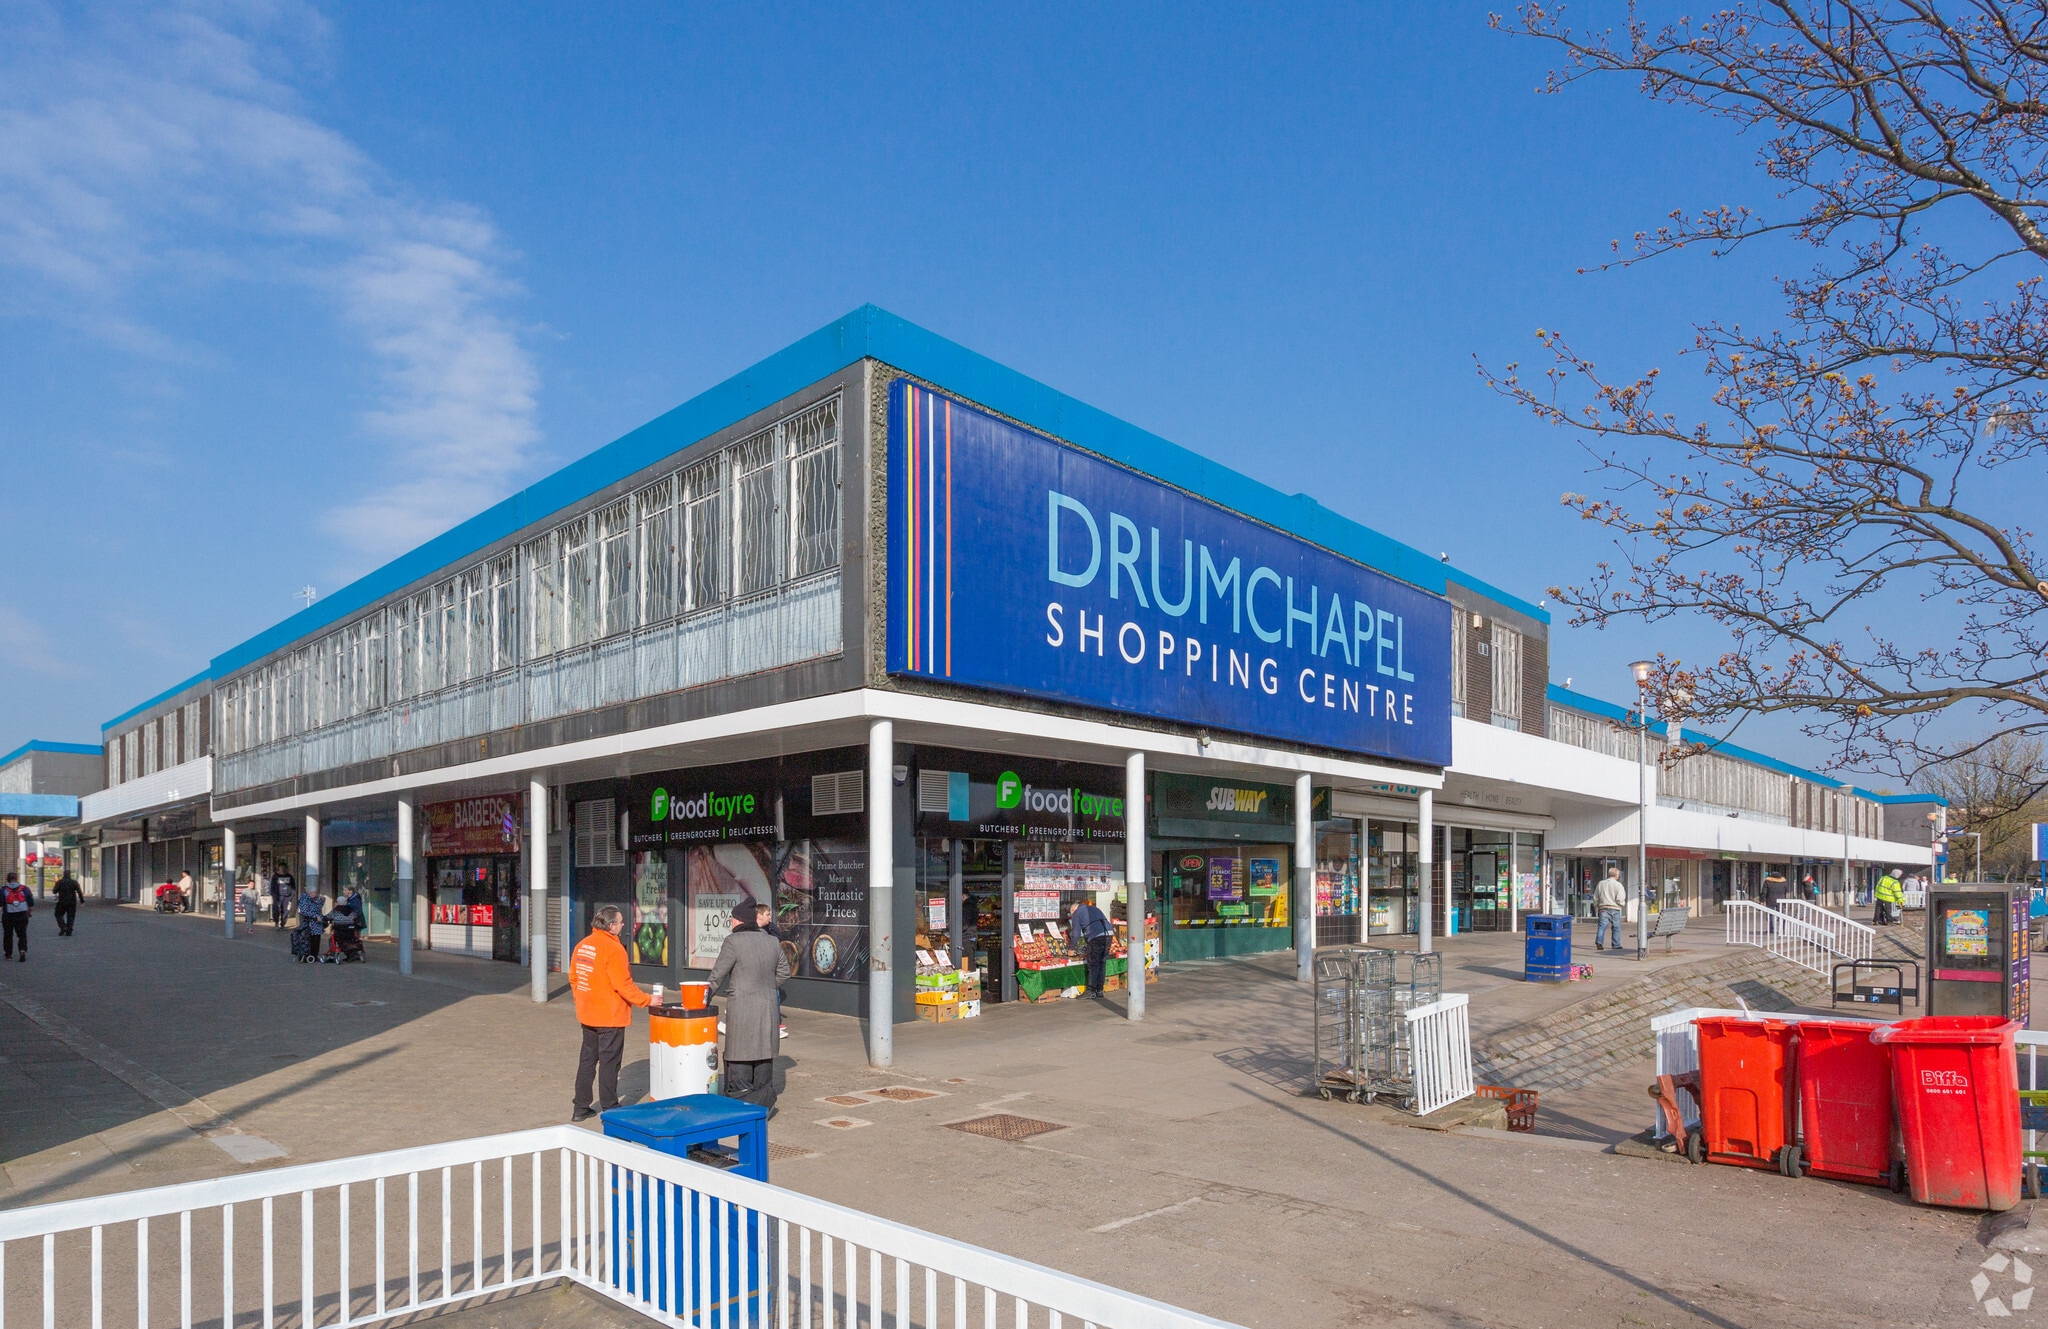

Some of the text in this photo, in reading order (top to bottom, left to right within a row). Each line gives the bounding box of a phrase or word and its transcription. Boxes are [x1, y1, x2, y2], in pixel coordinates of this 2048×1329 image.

[1048, 490, 1415, 682] DRUMCHAPEL
[1046, 602, 1414, 726] SHOPPING CENTRE
[1206, 787, 1267, 813] SUBWAY
[1460, 790, 1522, 806] HEALTH HOME BEAUTY
[455, 798, 503, 828] BARBERS
[634, 825, 778, 843] BUTCHERS GREENGROCERS DELICATESSEN
[980, 824, 1019, 834] BUTCHERS
[1029, 826, 1084, 836] GREENGROCERS
[817, 860, 865, 870] Prime Butcher
[1182, 858, 1202, 868] OPEN
[829, 874, 844, 883] Meat
[1211, 874, 1223, 885] £3
[818, 886, 864, 901] Fantastic
[698, 898, 715, 908] SAVE
[715, 898, 725, 908] UP
[825, 903, 857, 918] Prices
[704, 910, 731, 931] 40%
[1921, 1069, 1968, 1087] Biffa
